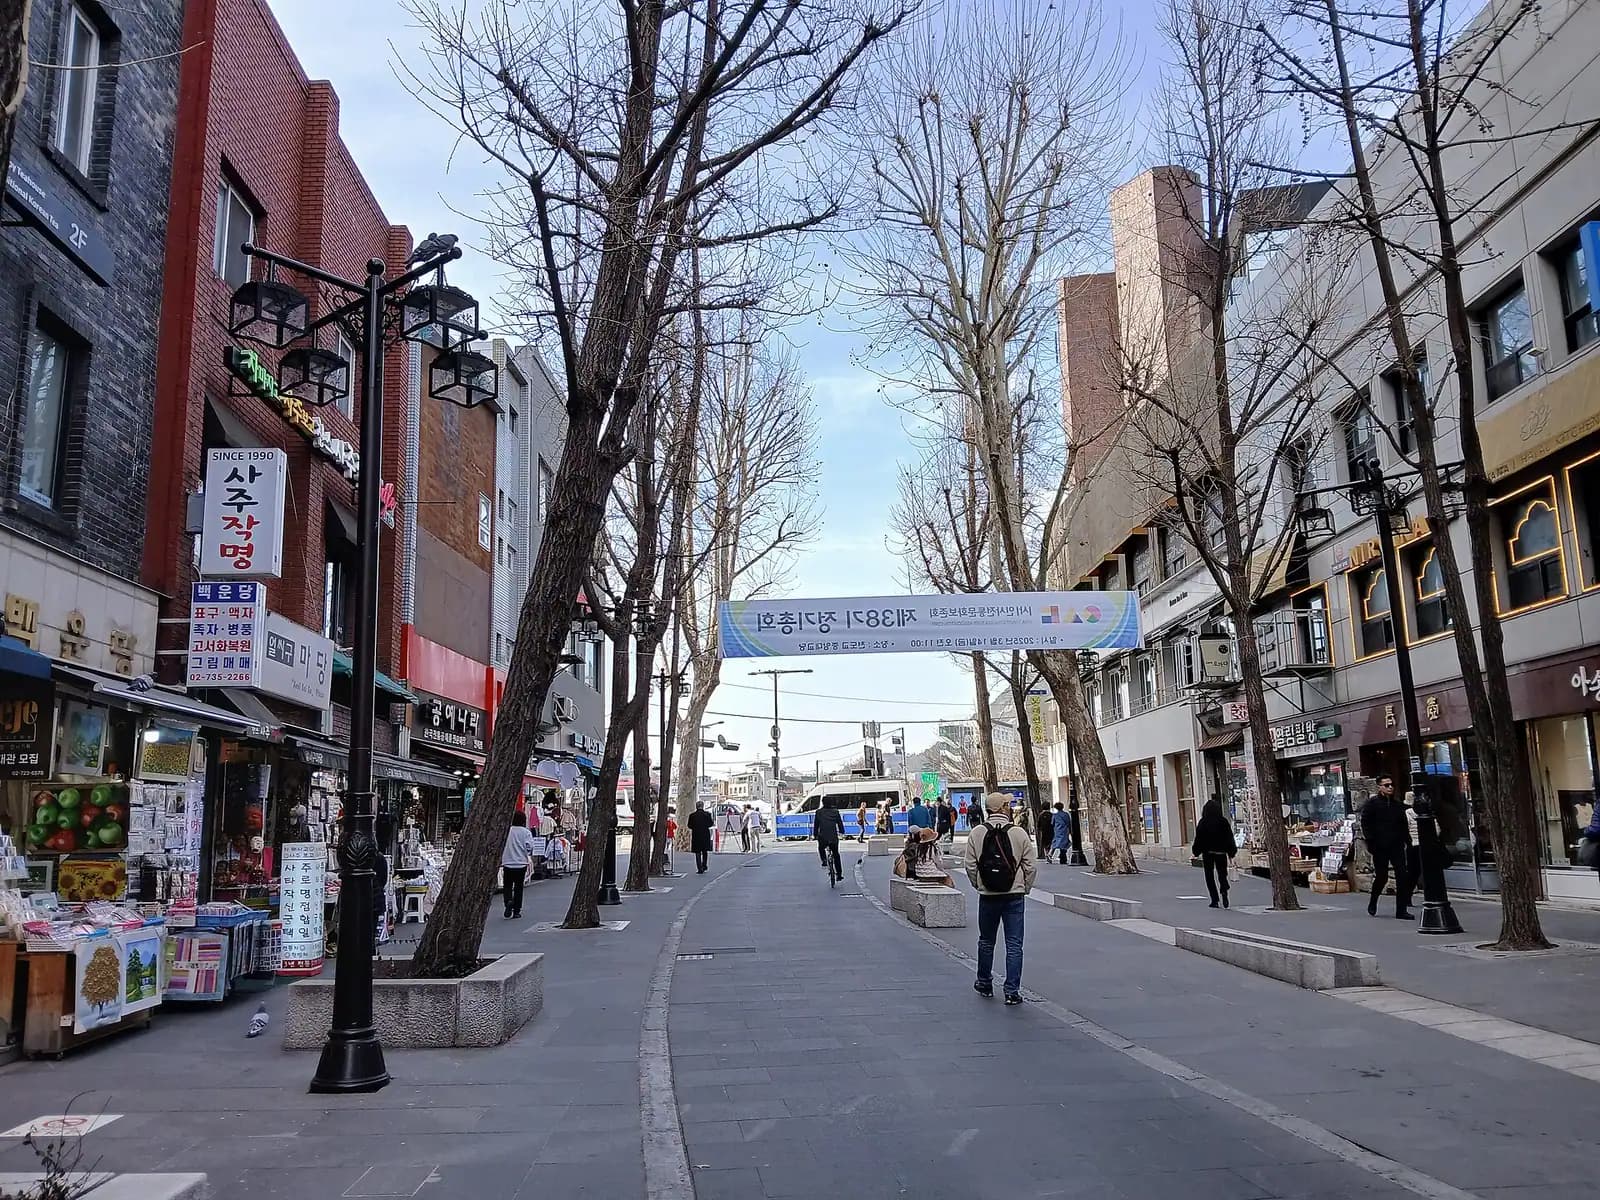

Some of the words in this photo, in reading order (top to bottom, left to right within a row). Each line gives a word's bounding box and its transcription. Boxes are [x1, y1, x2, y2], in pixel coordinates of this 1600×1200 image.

[17, 167, 46, 199] Teahouse
[28, 192, 51, 221] Korean
[48, 214, 60, 230] Tea
[69, 222, 88, 249] 2F
[212, 452, 243, 461] SINCE
[247, 451, 274, 461] 1990
[198, 584, 253, 600] 백운당
[191, 640, 251, 653] 고서화복원
[189, 673, 250, 682] 02-735-2266
[431, 698, 481, 737] 공예나라
[18, 752, 39, 765] 모집
